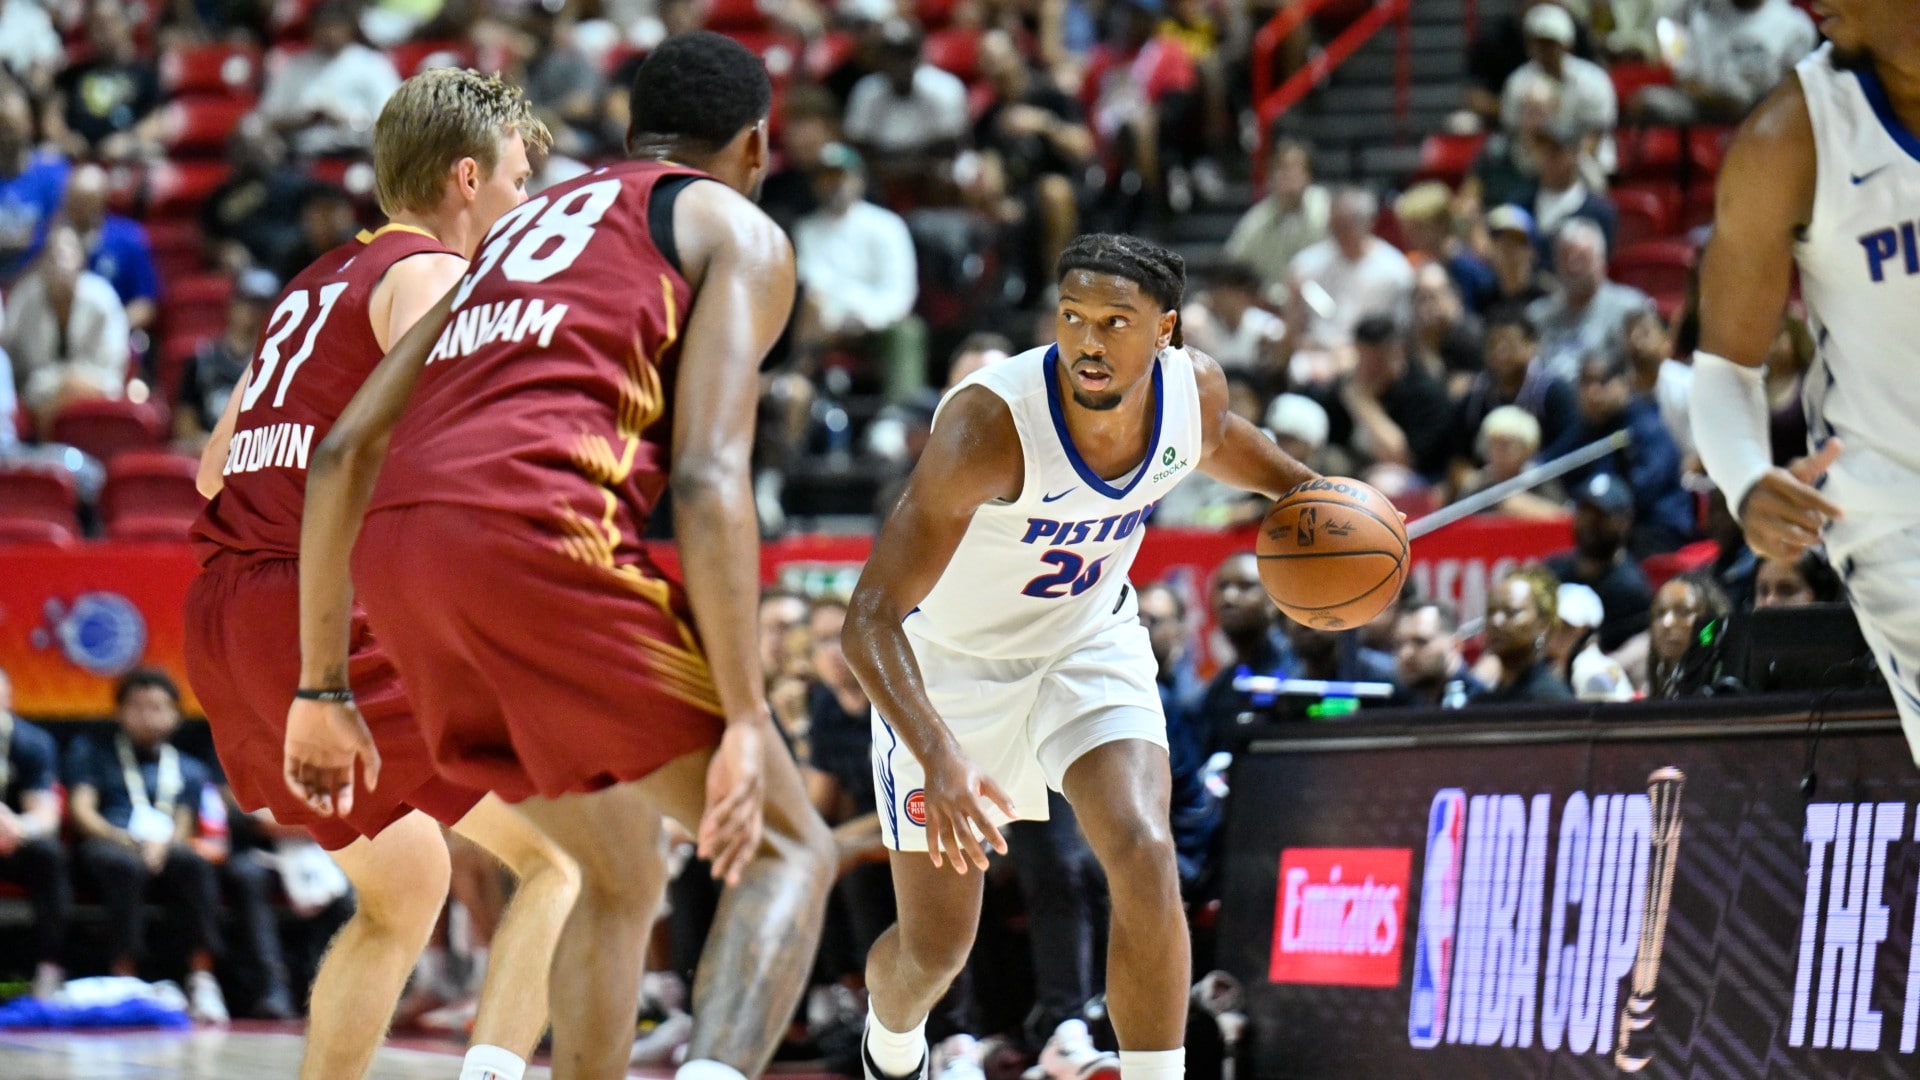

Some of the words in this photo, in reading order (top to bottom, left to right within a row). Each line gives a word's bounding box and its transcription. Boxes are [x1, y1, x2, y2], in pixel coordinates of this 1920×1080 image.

[451, 178, 622, 312] 38
[1858, 218, 1920, 282] PI
[240, 281, 349, 413] 31
[1446, 793, 1551, 1049] NBA
[1541, 790, 1652, 1055] CUP
[1790, 802, 1906, 1052] THE
